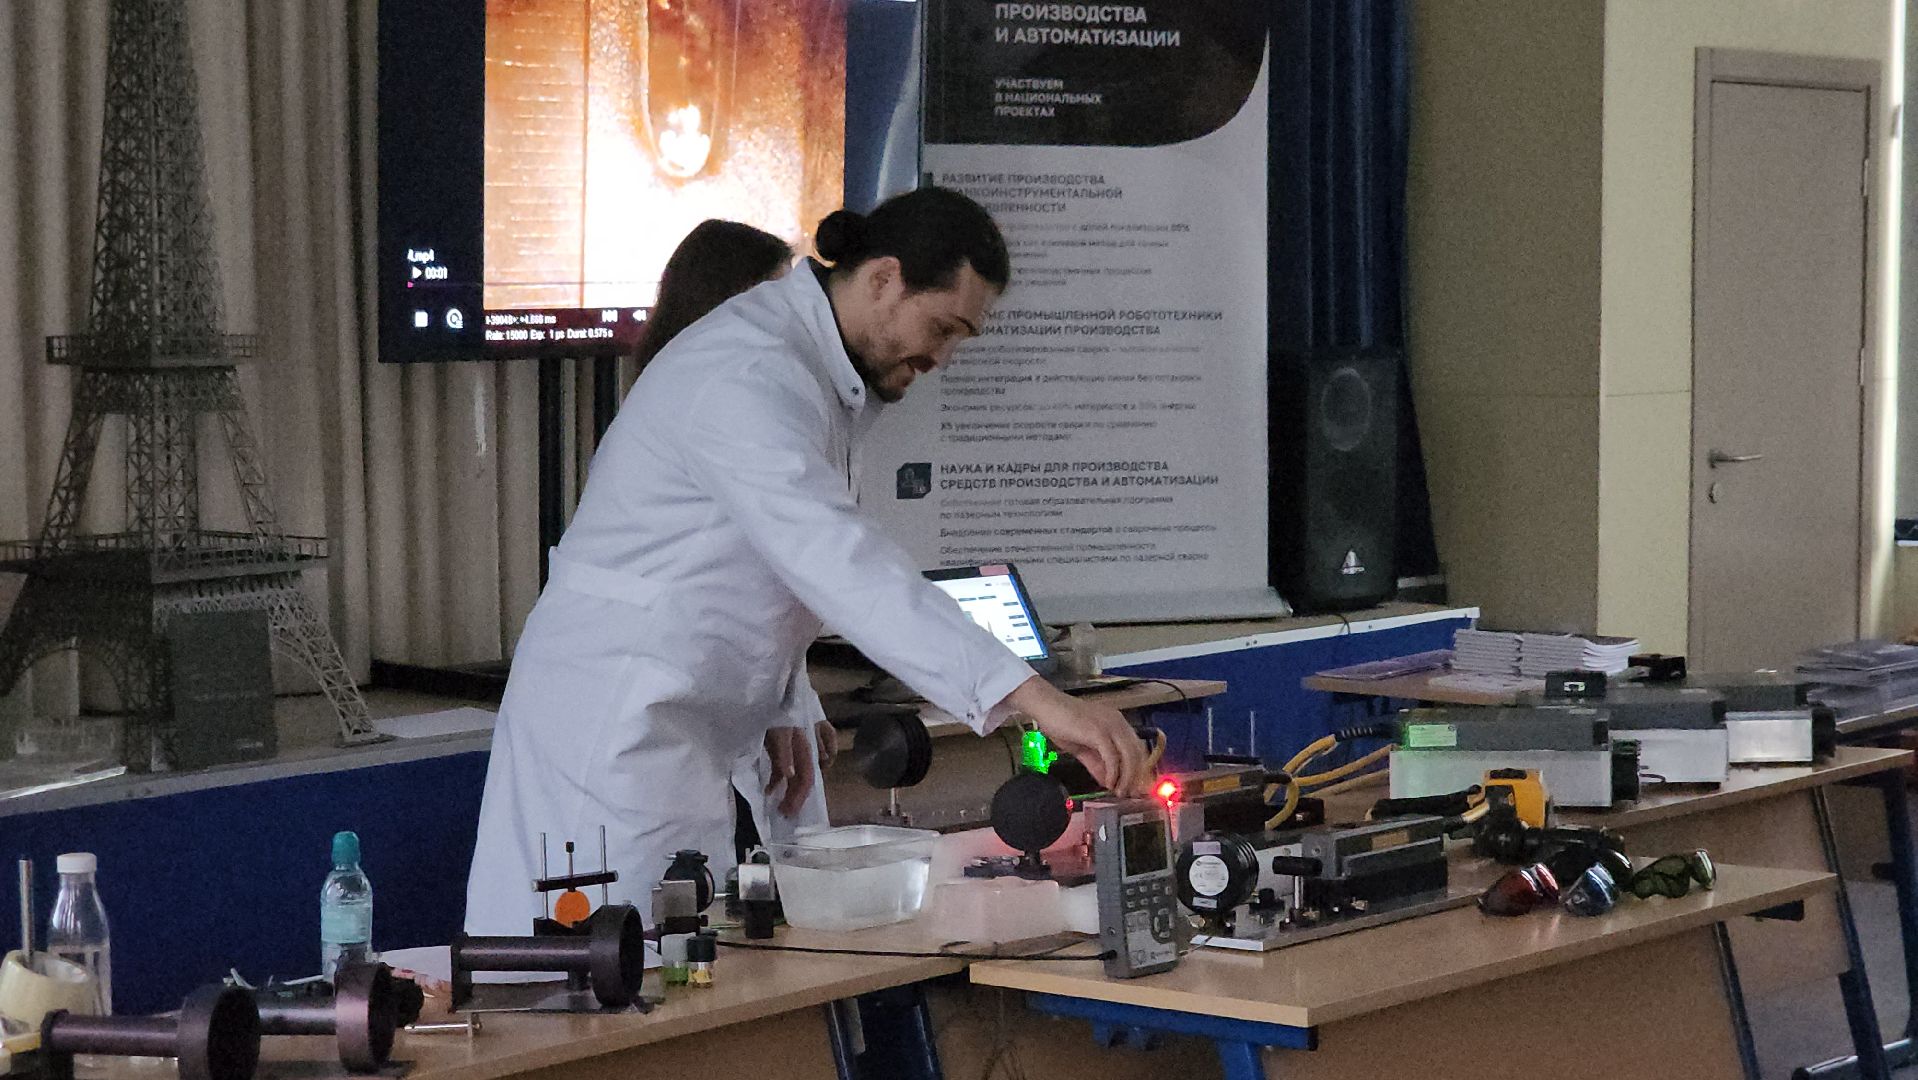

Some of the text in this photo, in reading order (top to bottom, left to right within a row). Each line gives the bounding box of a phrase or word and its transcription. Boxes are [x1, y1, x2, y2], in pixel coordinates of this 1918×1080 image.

[995, 3, 1148, 23] ПРОИЗВОДСТВА
[995, 27, 1181, 48] И АВТОМАТИЗАЦИИ
[995, 78, 1064, 90] УЧАСТВУЕМ
[995, 93, 1102, 105] В НАЦИОНАЛЬНЫХ
[995, 106, 1055, 117] ПРОЕКТАХ
[942, 173, 1106, 185] РАЗВИТИЕ ПРОИЗВОДСТВА
[955, 186, 1123, 199] АНКОИНСТРУМЕНТАЛЬНОЙ
[425, 266, 448, 280] 00:01
[1007, 308, 1116, 321] ПРОМЫШЛЕННОЙ
[1119, 310, 1223, 321] РОБОТОТЕХНИКИ
[1064, 325, 1161, 336] ПРОИЗВОДСТВА
[940, 461, 1169, 475] НАУКА И КАДРЫ ДЛЯ ПРОИЗВОДСТВА
[940, 475, 1219, 490] СРЕДСТВ ПРОИЗВОДСТВА И АВТОМАТИЗАЦИИ
